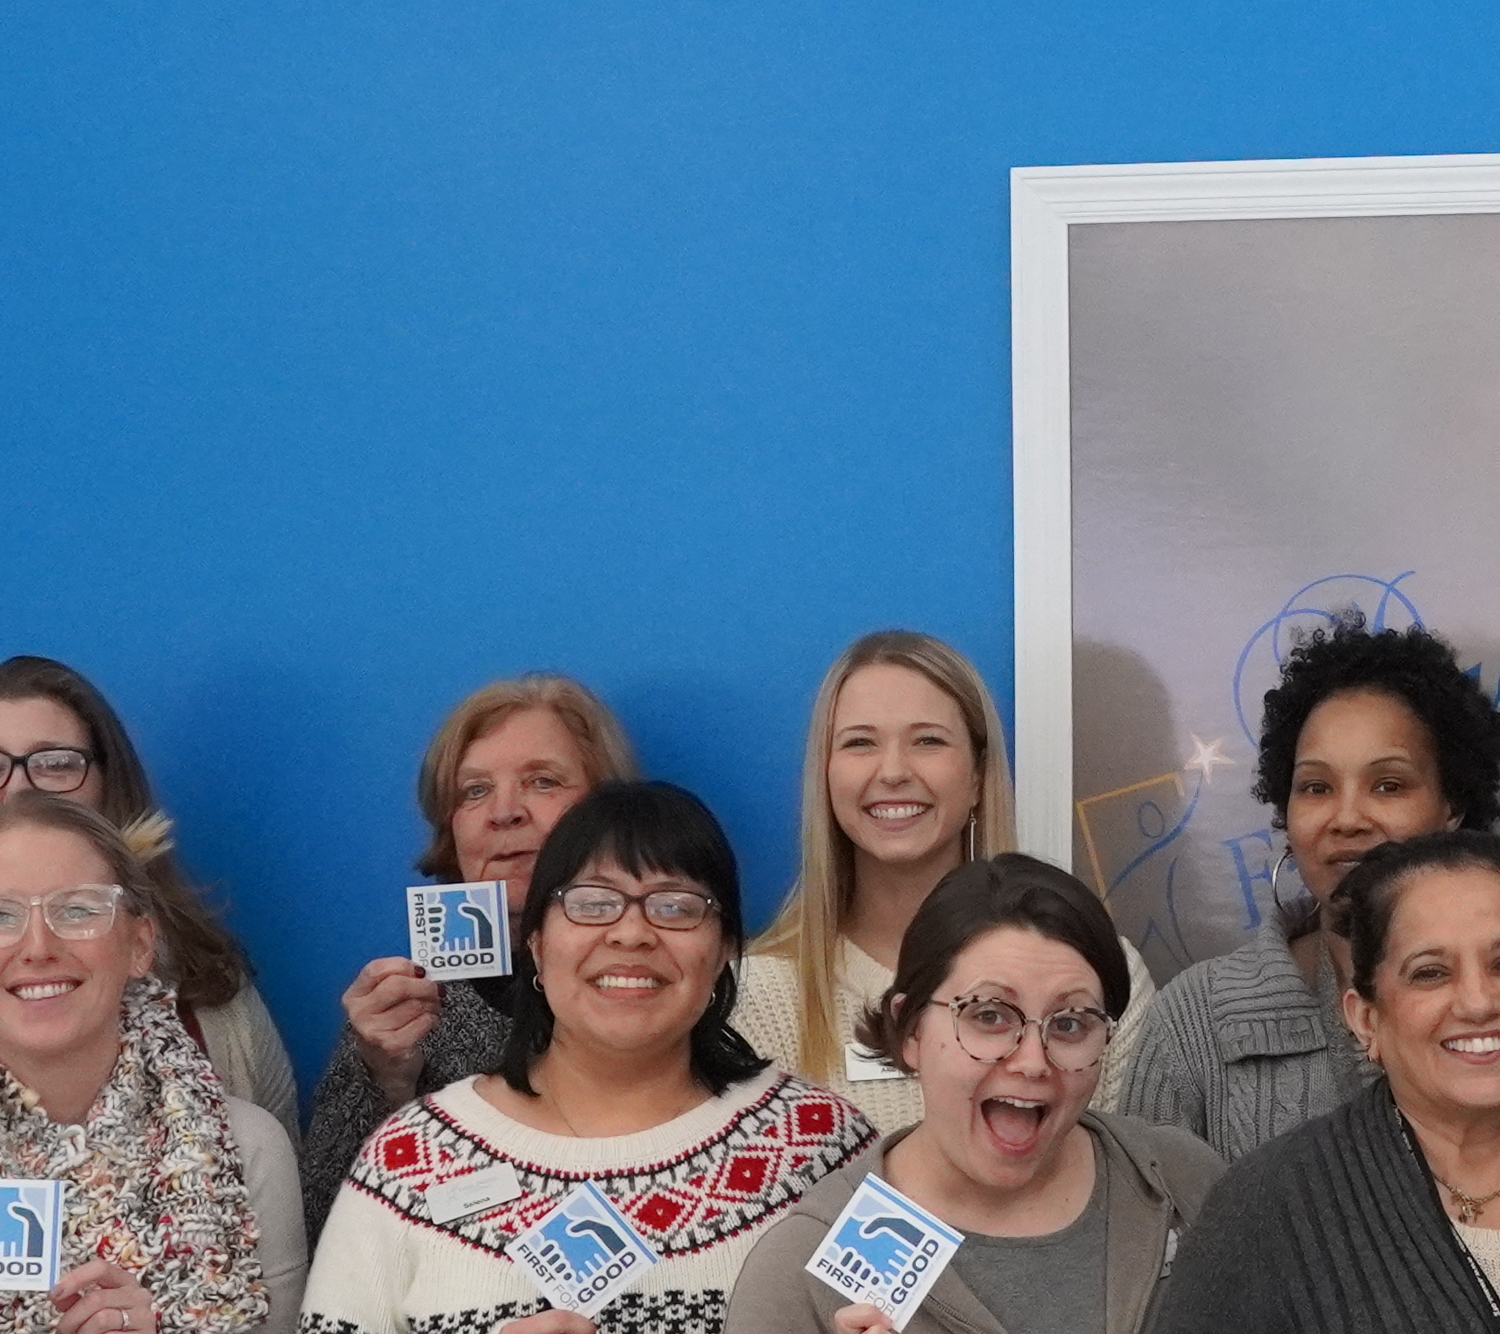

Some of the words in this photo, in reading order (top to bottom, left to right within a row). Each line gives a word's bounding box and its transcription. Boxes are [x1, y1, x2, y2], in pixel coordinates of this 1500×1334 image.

[414, 893, 426, 937] FIRST
[417, 941, 428, 968] FOR
[430, 953, 495, 969] GOOD
[516, 1243, 556, 1285] FIRST
[552, 1283, 580, 1312] FOR
[577, 1251, 637, 1304] GOOD
[816, 1258, 866, 1293] FIRST
[864, 1290, 896, 1317] FOR
[890, 1239, 940, 1305] GOOD
